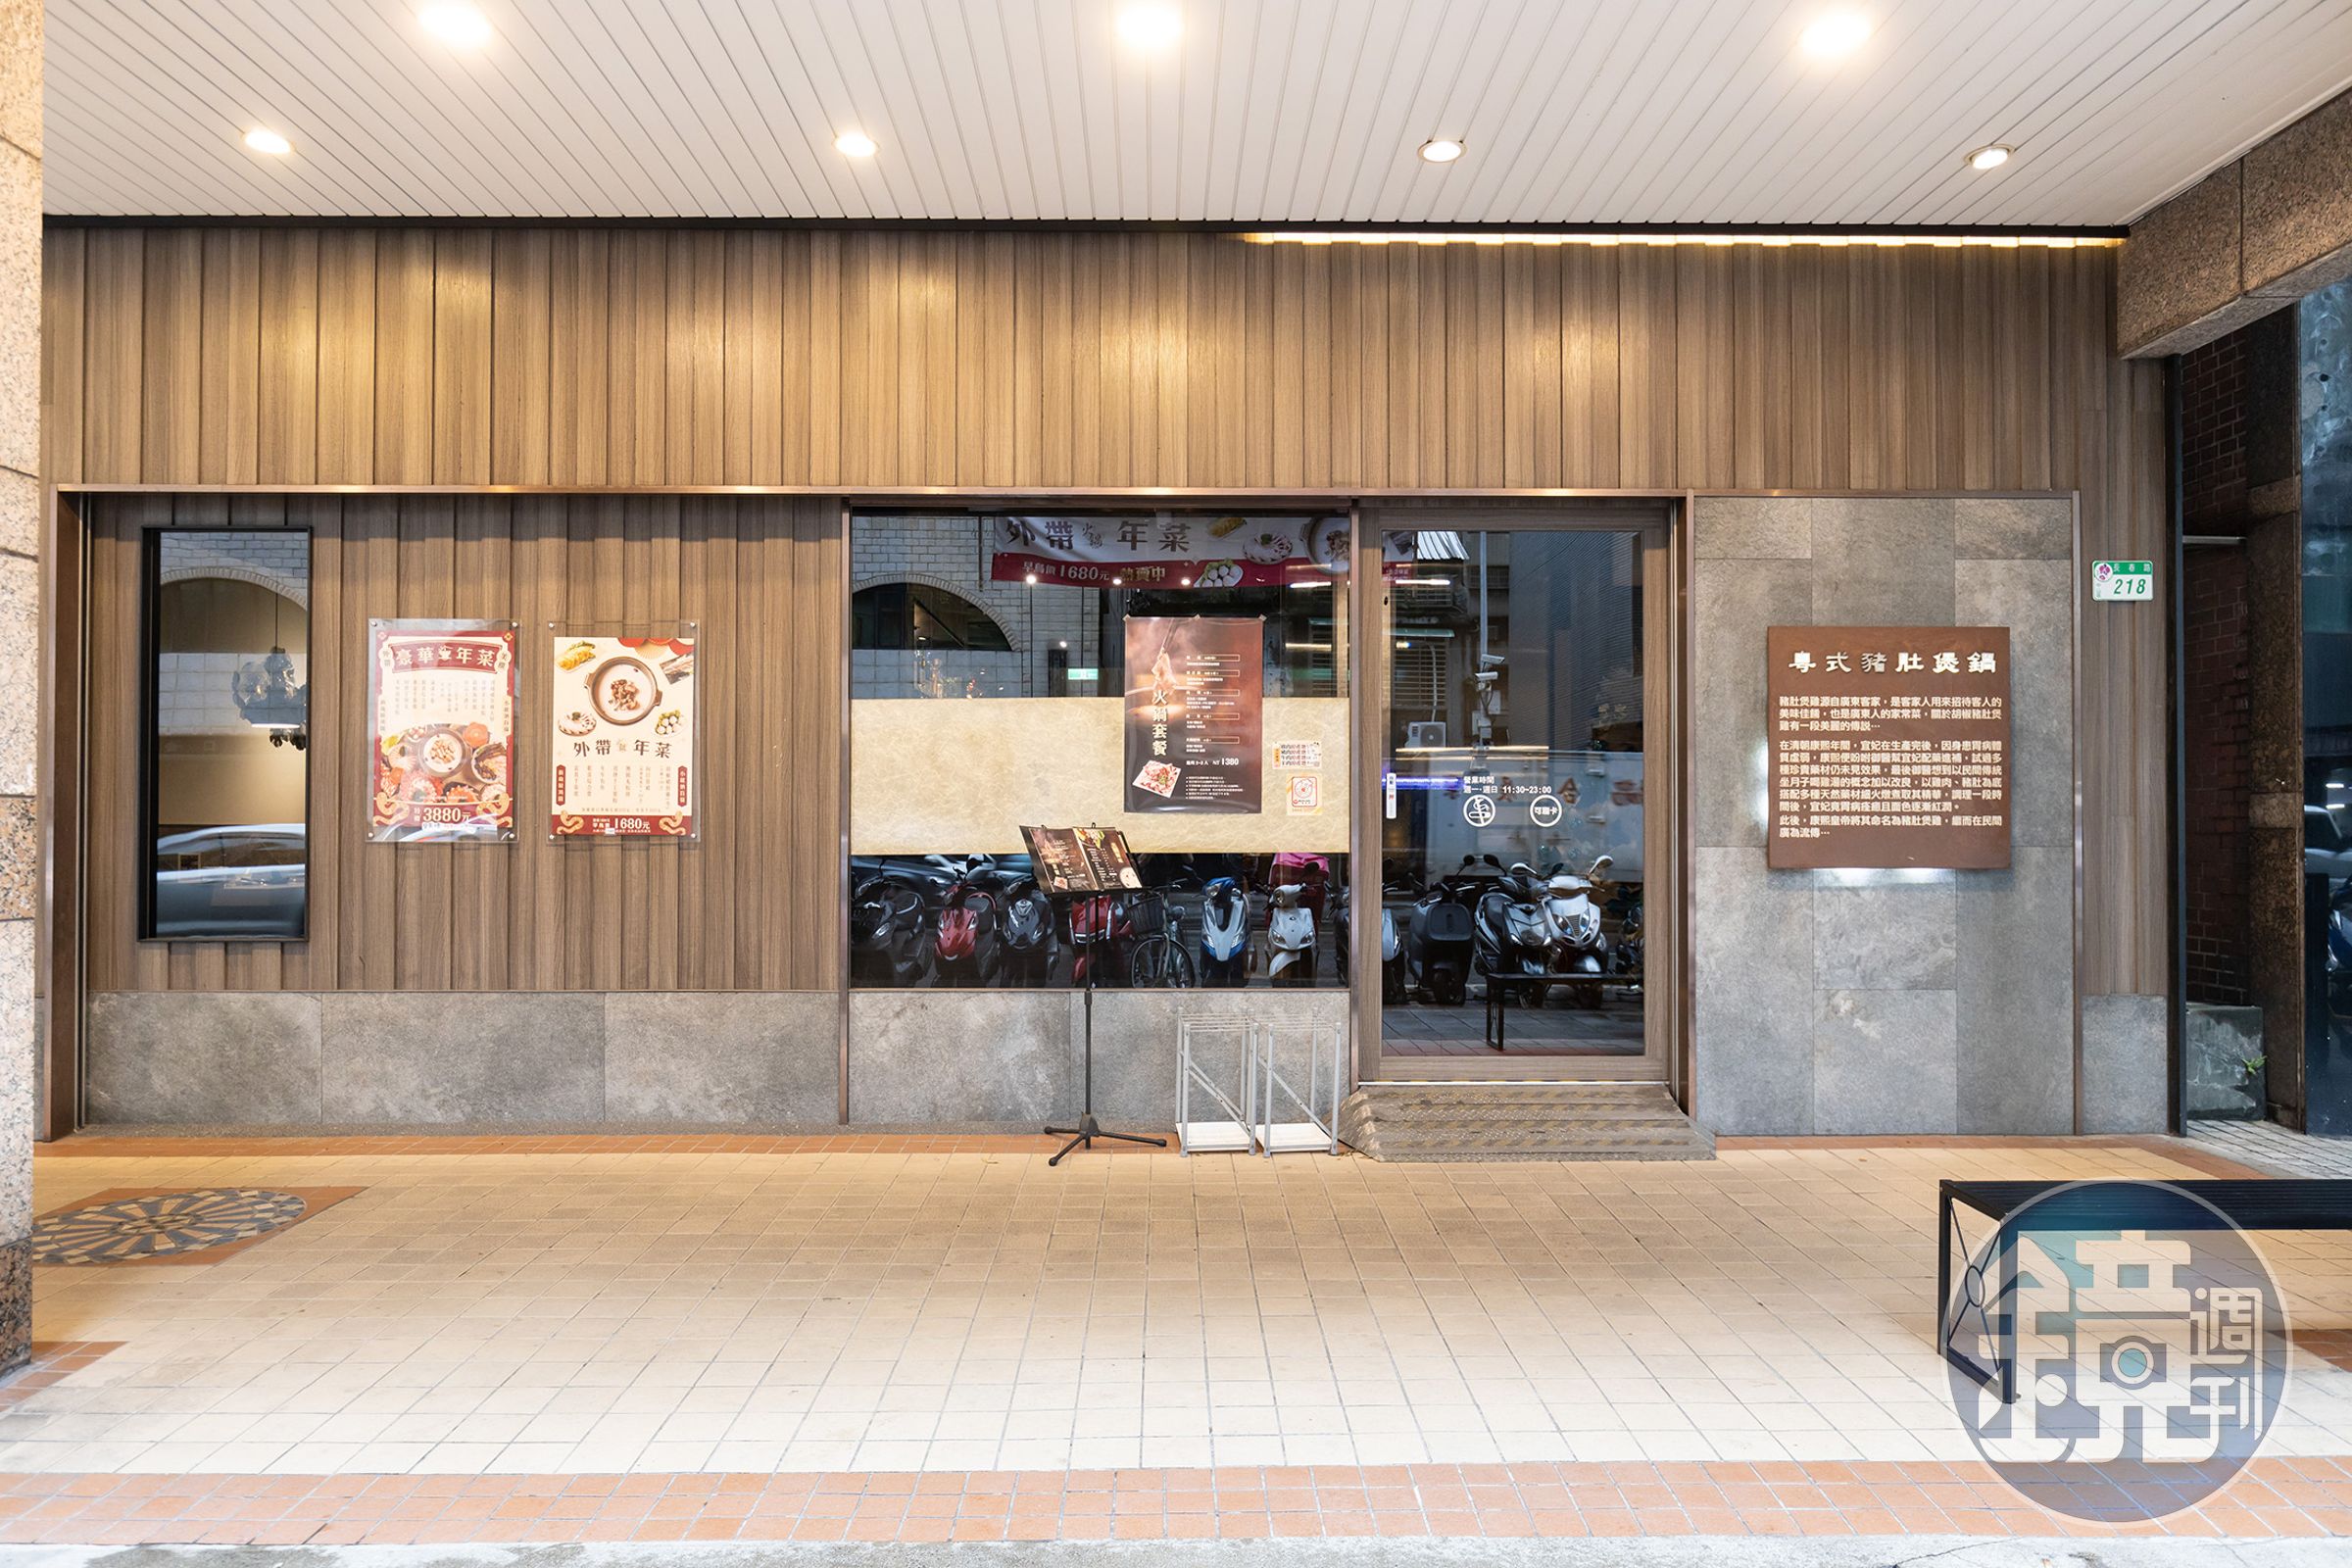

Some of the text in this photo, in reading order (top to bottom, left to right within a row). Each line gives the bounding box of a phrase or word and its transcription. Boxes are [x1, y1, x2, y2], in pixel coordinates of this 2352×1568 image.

[1005, 519, 1074, 550] 外帶
[1117, 520, 1192, 553] 年菜
[1059, 564, 1110, 581] 1680元
[2114, 578, 2146, 595] 218
[1788, 651, 1996, 674] 粵式豬肚煲鍋
[1152, 690, 1168, 757] 火鍋套餐
[573, 739, 612, 758] 外帶
[633, 739, 672, 759] 年菜
[614, 817, 651, 829] 1680元
